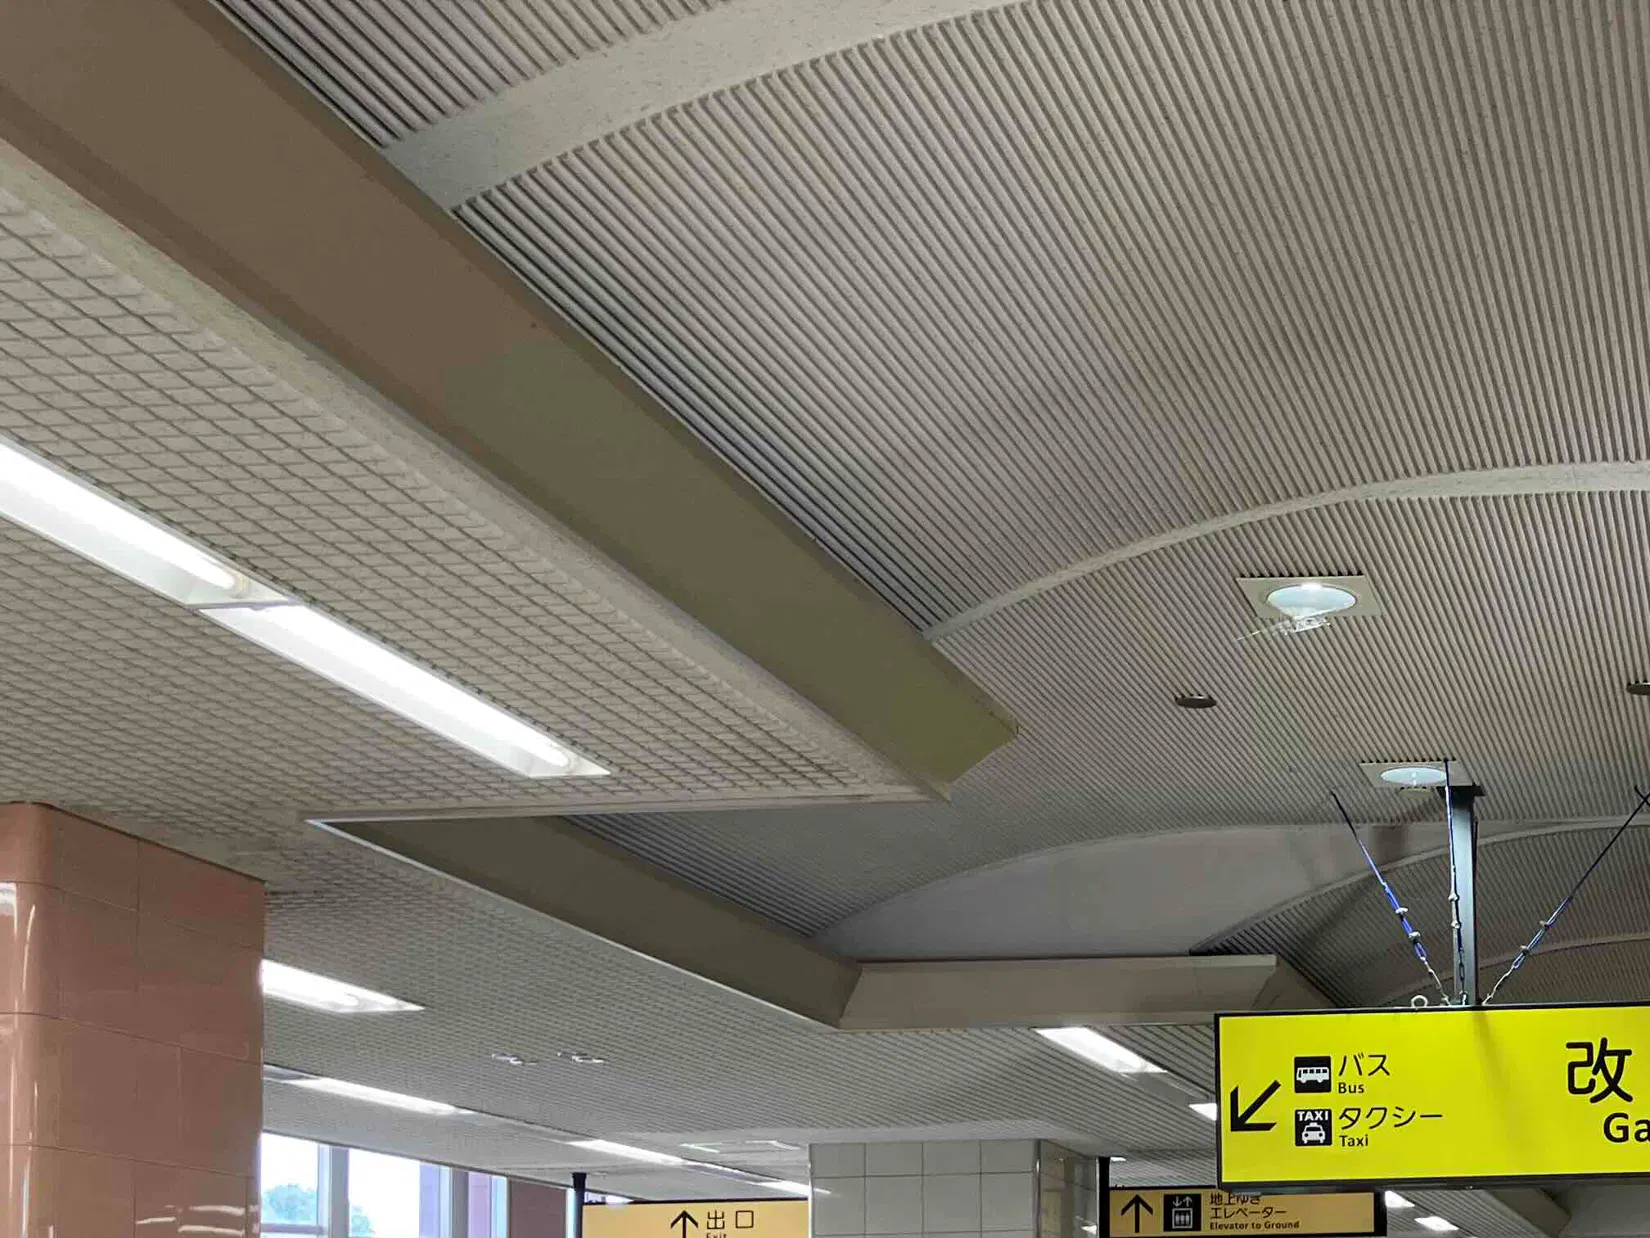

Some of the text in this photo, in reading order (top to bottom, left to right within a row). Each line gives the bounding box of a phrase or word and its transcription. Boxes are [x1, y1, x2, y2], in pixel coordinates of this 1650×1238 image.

[1338, 1052, 1391, 1077] バス
[1338, 1081, 1365, 1095] Bus
[1297, 1110, 1329, 1121] TAXI
[1339, 1105, 1443, 1130] タクシー
[1339, 1134, 1369, 1148] Taxi
[1209, 1192, 1262, 1206] 地上ゆき
[706, 1209, 755, 1230] 出口
[1210, 1206, 1287, 1219] エレベーター
[1209, 1220, 1300, 1231] Elevator to Ground
